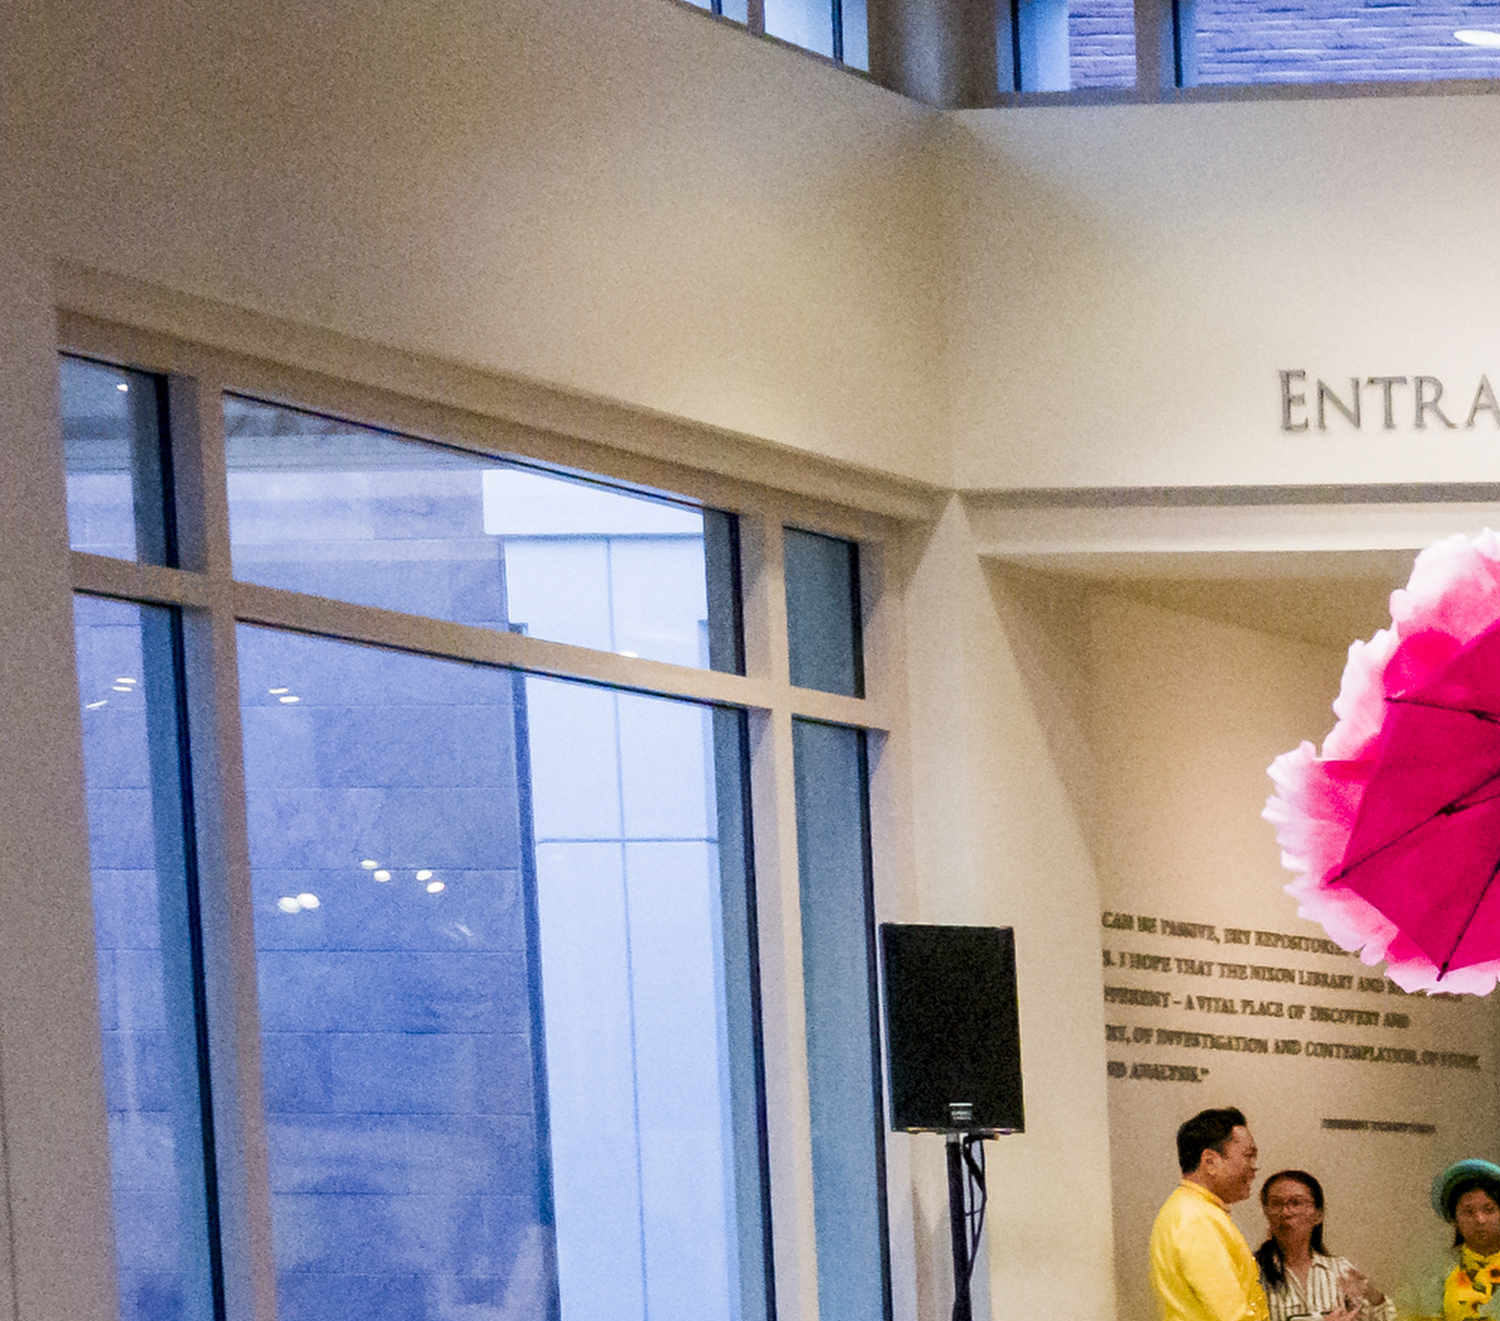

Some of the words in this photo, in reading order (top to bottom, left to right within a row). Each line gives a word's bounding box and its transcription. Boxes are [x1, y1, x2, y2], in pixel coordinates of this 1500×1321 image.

[1129, 953, 1172, 973] HOPE
[1174, 957, 1214, 977] THAT
[1217, 962, 1248, 981] THE
[1249, 965, 1296, 984] NIXON
[1298, 969, 1353, 990] LIBRARY
[1196, 995, 1238, 1014] VITAL
[1240, 999, 1284, 1018] PLACE
[1287, 1004, 1306, 1020] OF
